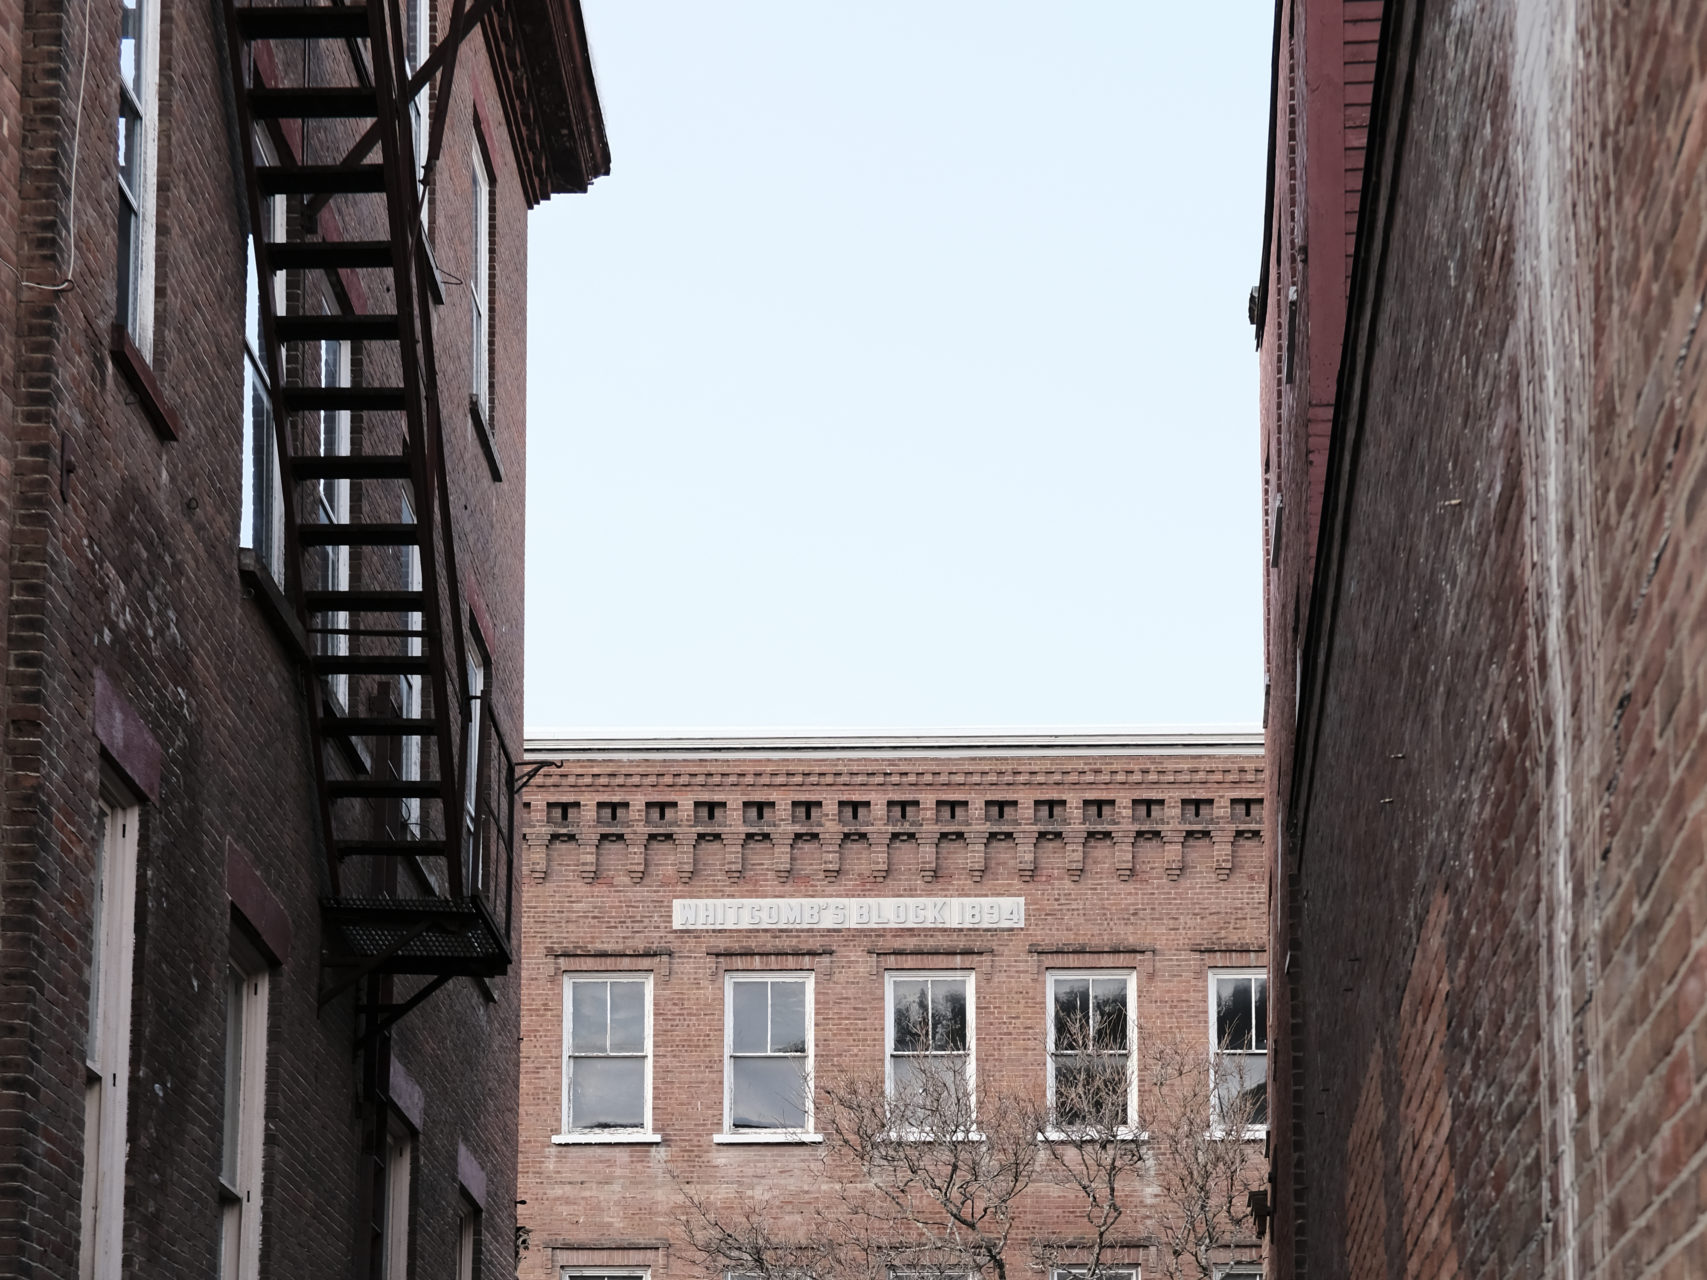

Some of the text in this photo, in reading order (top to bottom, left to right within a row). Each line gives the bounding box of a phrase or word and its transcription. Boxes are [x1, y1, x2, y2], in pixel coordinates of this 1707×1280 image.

[679, 901, 1020, 925] WHITCOMB'S BLOCK 1894
